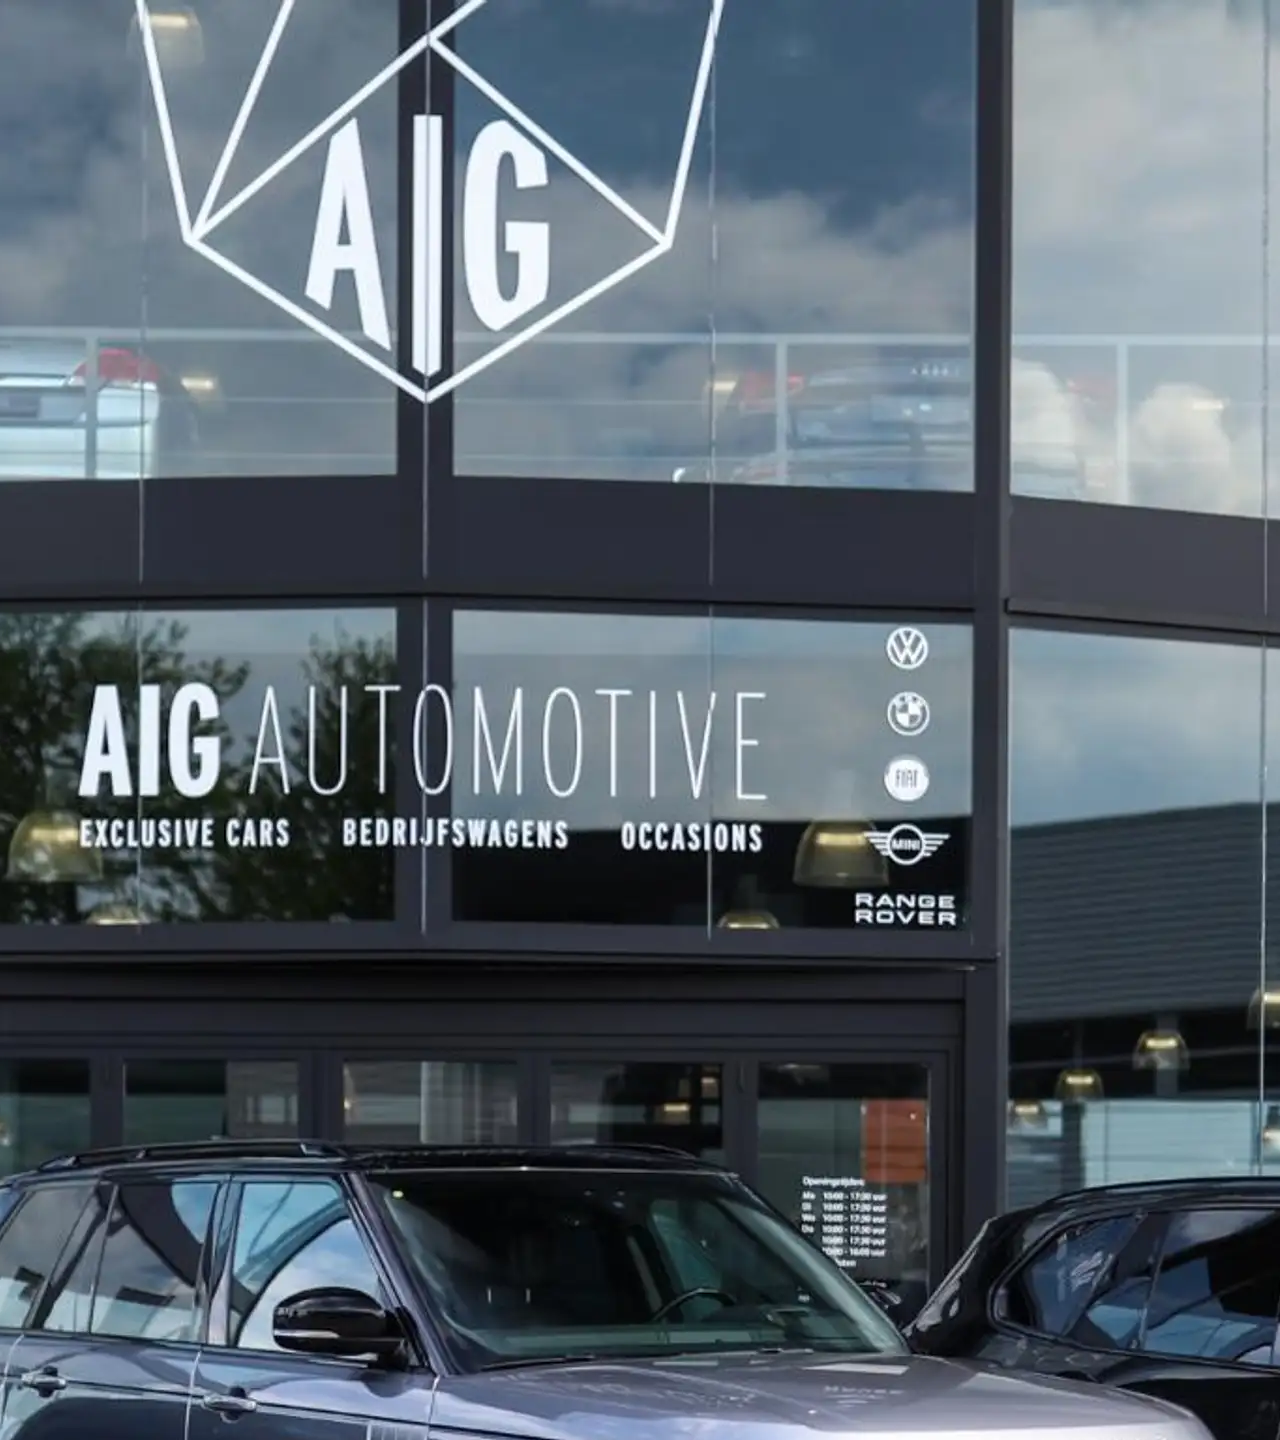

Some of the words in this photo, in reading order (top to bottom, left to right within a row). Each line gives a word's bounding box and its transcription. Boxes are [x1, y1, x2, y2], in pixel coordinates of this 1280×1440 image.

[304, 114, 550, 376] AIG
[79, 683, 220, 798] AIG
[249, 683, 767, 800] AUTOMOTIVE
[79, 818, 214, 848] EXCLUSIVE
[226, 818, 290, 848] CARS
[342, 817, 569, 849] BEDRIJFSWAGENS
[621, 820, 763, 852] OCCASIONS
[891, 839, 921, 851] MINI
[855, 893, 956, 909] RANGE
[855, 909, 957, 926] ROVER
